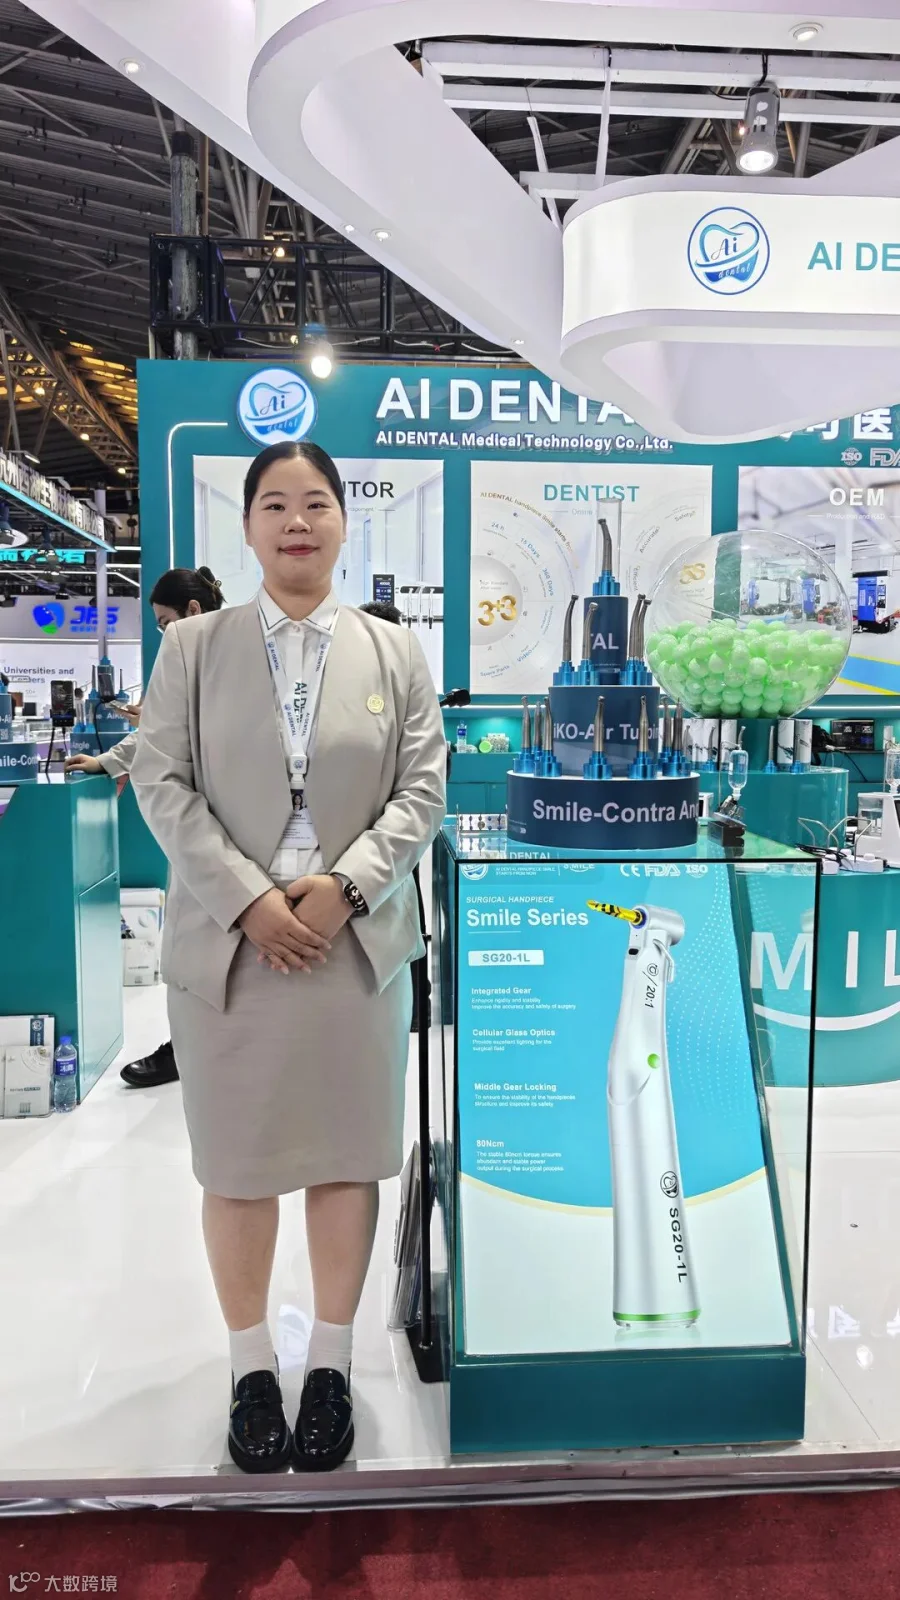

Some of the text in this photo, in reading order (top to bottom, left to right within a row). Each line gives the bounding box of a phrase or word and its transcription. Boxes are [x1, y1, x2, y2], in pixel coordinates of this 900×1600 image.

[808, 242, 900, 271] AI DE
[376, 377, 430, 420] AI
[376, 430, 392, 444] AI
[396, 431, 458, 446] DENTAL
[462, 432, 520, 448] Medical
[524, 434, 612, 450] Technology
[342, 480, 394, 498] TOR
[488, 492, 514, 502] DENTAL
[544, 484, 640, 502] DENTIST
[830, 488, 884, 506] OEM
[528, 544, 540, 558] Days
[590, 632, 620, 650] AL
[4, 666, 56, 674] Universities
[532, 799, 676, 824] Smile-Contra
[685, 864, 708, 874] ISO
[466, 908, 588, 926] Smile Series
[482, 952, 530, 963] SG20-1L
[472, 986, 510, 996] Integrated
[472, 1028, 556, 1038] Cellular Glass Optics
[474, 1082, 501, 1090] Middle
[524, 1082, 557, 1092] Locking
[476, 1139, 504, 1148] 80Ncm
[670, 1208, 687, 1282] SG20-1L
